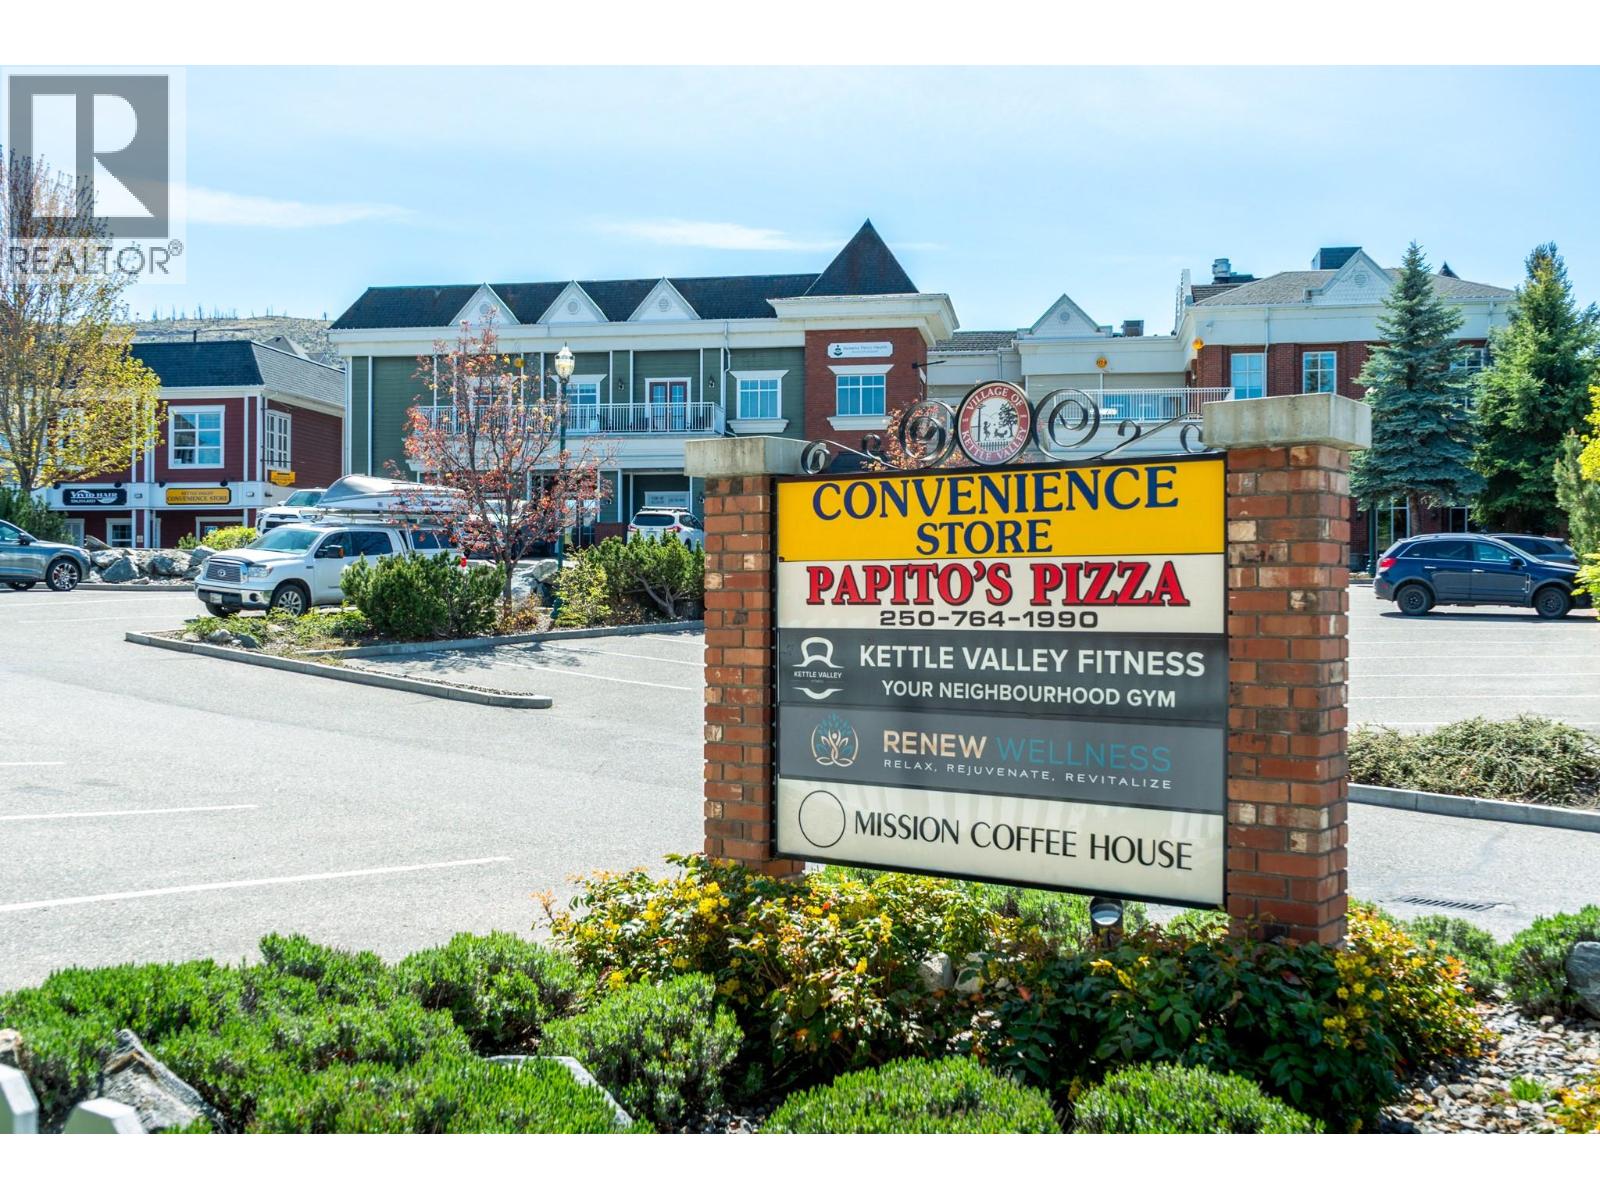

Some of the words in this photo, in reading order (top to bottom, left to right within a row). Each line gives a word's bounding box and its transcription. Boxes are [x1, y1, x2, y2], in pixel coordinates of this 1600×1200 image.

[966, 387, 1008, 410] VILLAGE
[1010, 393, 1024, 407] OF
[961, 430, 992, 460] KETTLE
[997, 427, 1027, 460] VALLEY
[812, 466, 1179, 521] CONVENIENCE
[916, 519, 1053, 555] STORE
[1030, 560, 1191, 607] PIZZA
[879, 610, 1099, 629] 250-764-1990
[817, 671, 843, 679] VALLEY
[860, 644, 954, 671] KETTLE
[962, 647, 1069, 674] VALLEY
[1078, 650, 1206, 678] FITNESS
[881, 679, 936, 700] YOUR
[939, 682, 1120, 706] NEIGHBOURHOOD
[1126, 689, 1177, 709] GYM
[883, 729, 988, 760] RENEW
[995, 736, 1173, 773] WELLNESS
[883, 759, 938, 773] RELAX,
[946, 764, 1056, 782] REJUVENATE,
[1065, 772, 1173, 790] REVITALIZE
[854, 809, 960, 845] MISSION
[970, 820, 1077, 858] COFFEE
[1089, 833, 1193, 871] HOUSE
